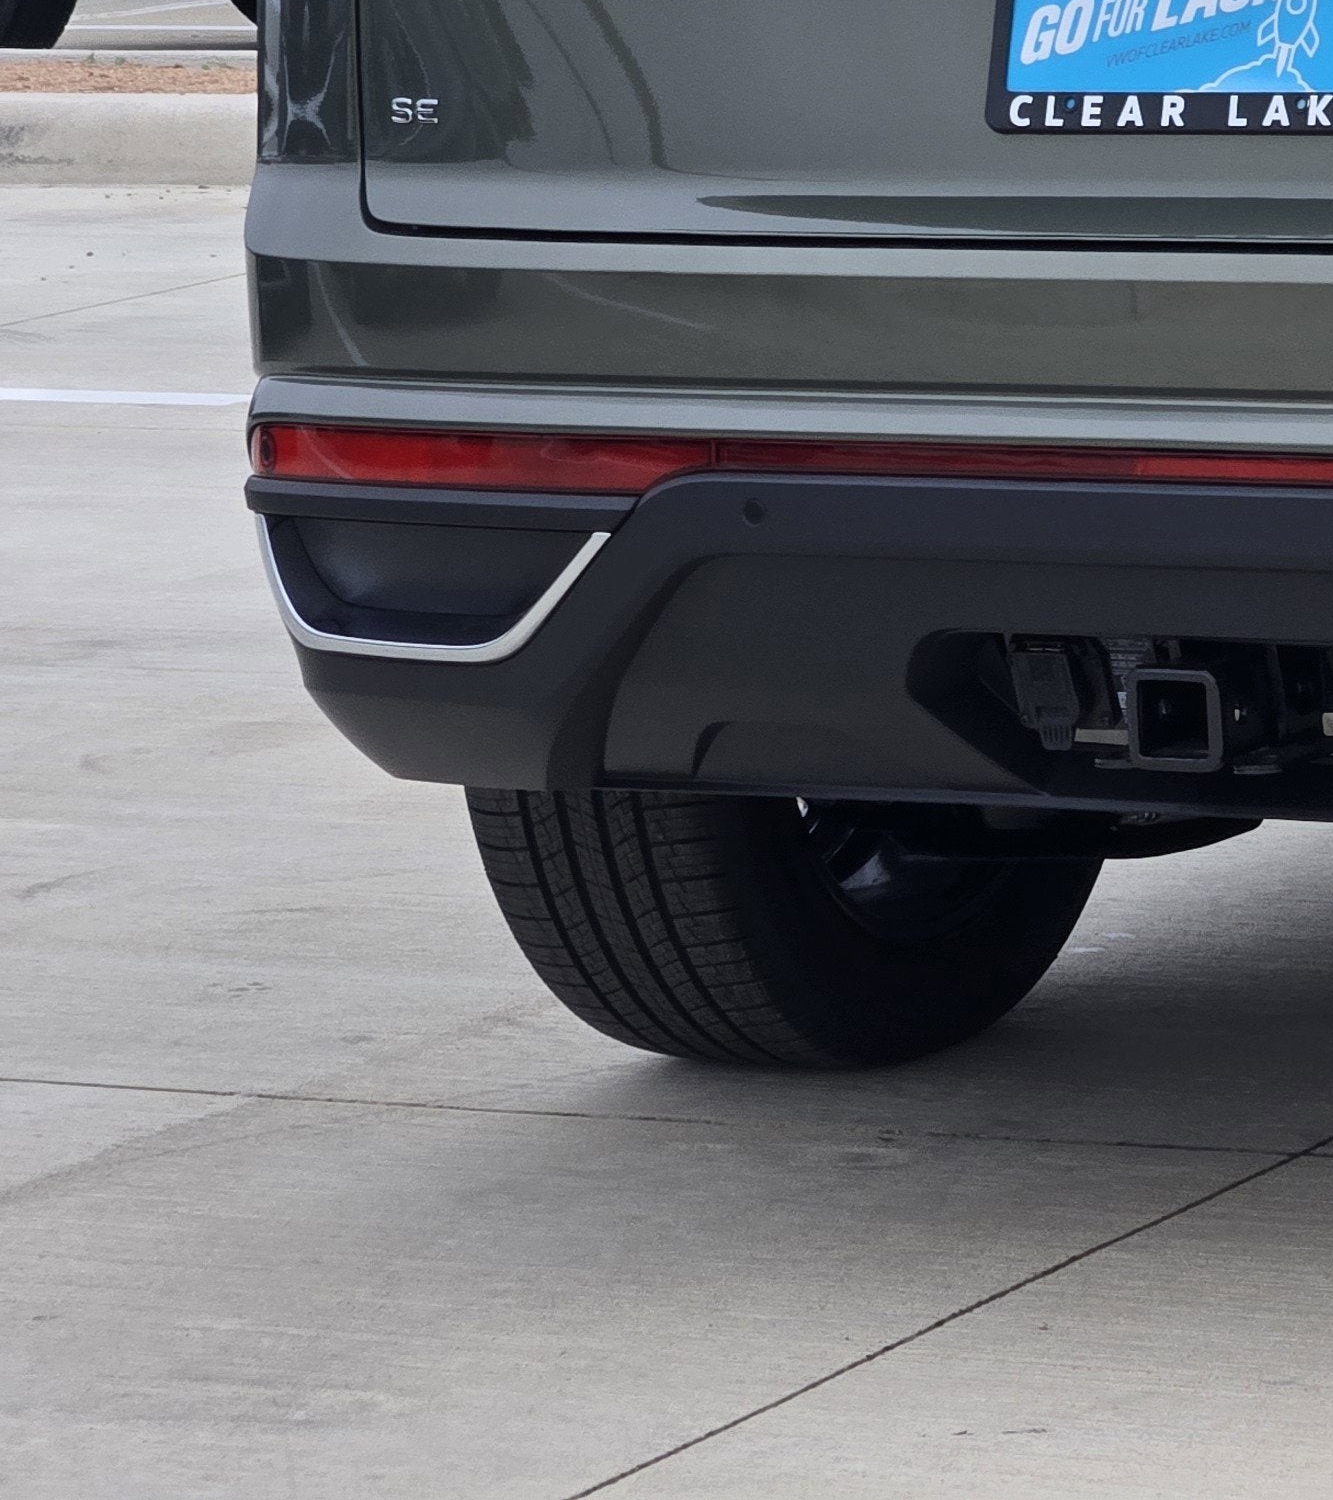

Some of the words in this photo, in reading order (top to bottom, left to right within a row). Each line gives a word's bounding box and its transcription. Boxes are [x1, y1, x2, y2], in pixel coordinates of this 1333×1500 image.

[1106, 21, 1251, 68] VWOFCLEARLAKE.COM
[391, 97, 438, 123] SE
[1009, 95, 1185, 127] CLEAR
